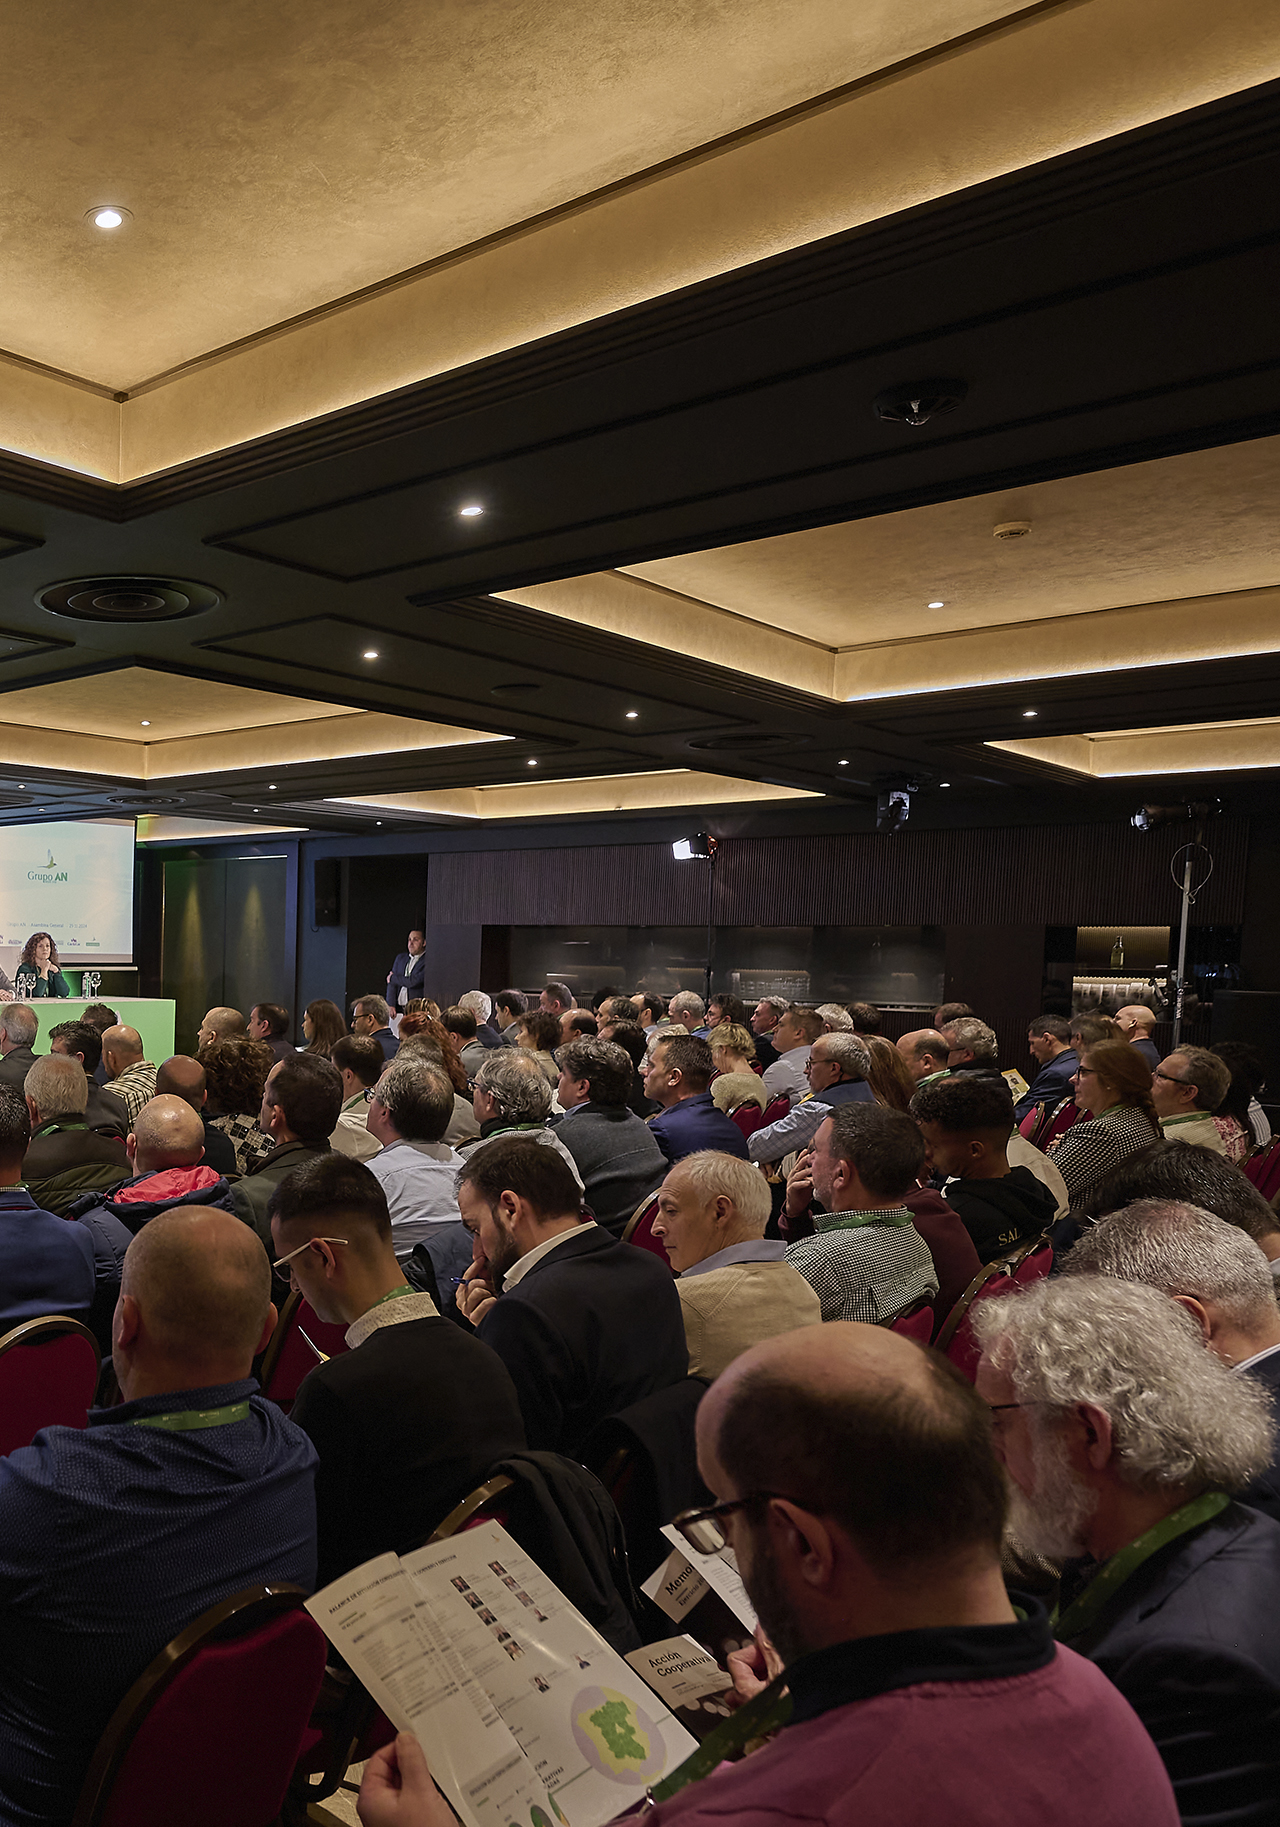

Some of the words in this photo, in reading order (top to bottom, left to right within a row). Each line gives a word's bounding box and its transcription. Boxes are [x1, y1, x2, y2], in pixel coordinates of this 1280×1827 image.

[27, 871, 53, 883] Grupo
[55, 872, 68, 882] AN
[648, 1651, 682, 1668] Acción
[656, 1656, 712, 1678] Cooperativa
